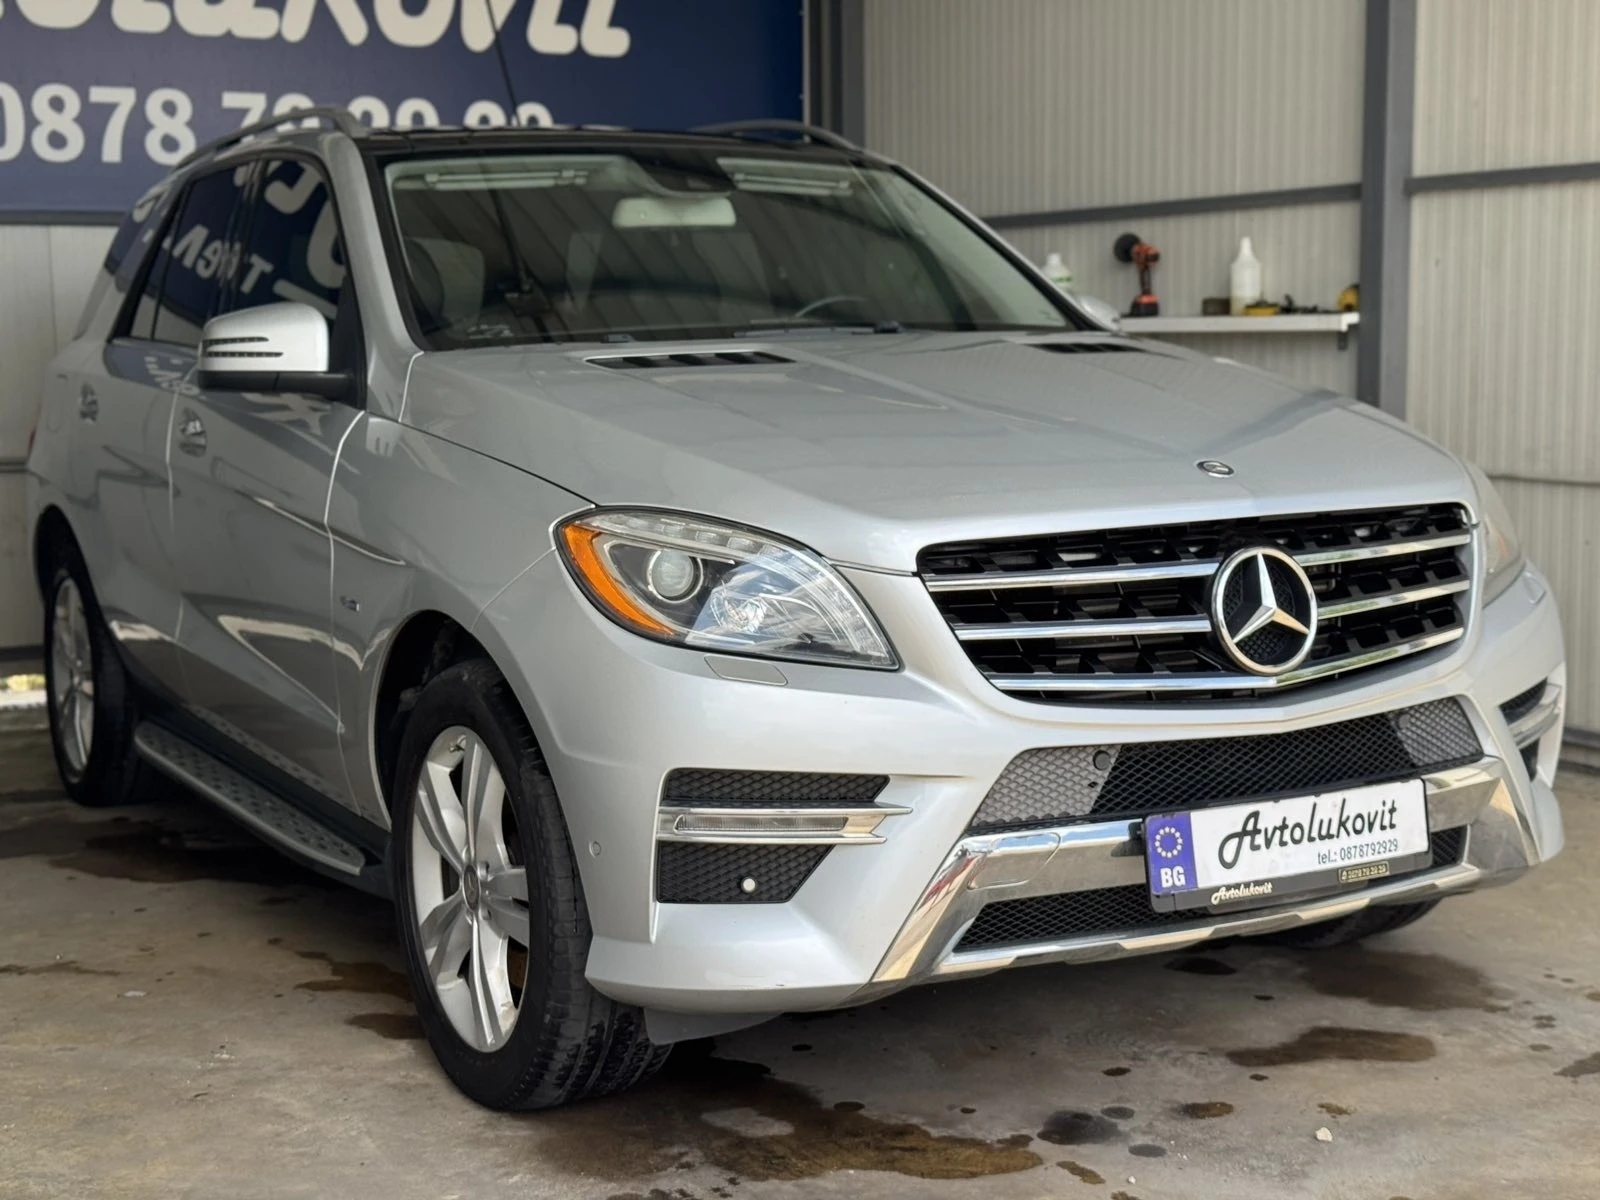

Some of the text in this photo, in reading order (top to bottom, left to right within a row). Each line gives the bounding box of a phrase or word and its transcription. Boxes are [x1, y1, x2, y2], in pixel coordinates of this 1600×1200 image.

[1218, 797, 1398, 870] Avtolukovit
[1340, 838, 1399, 861] 0878792929
[1160, 865, 1186, 888] BG
[1211, 881, 1272, 905] Avtolukovit
